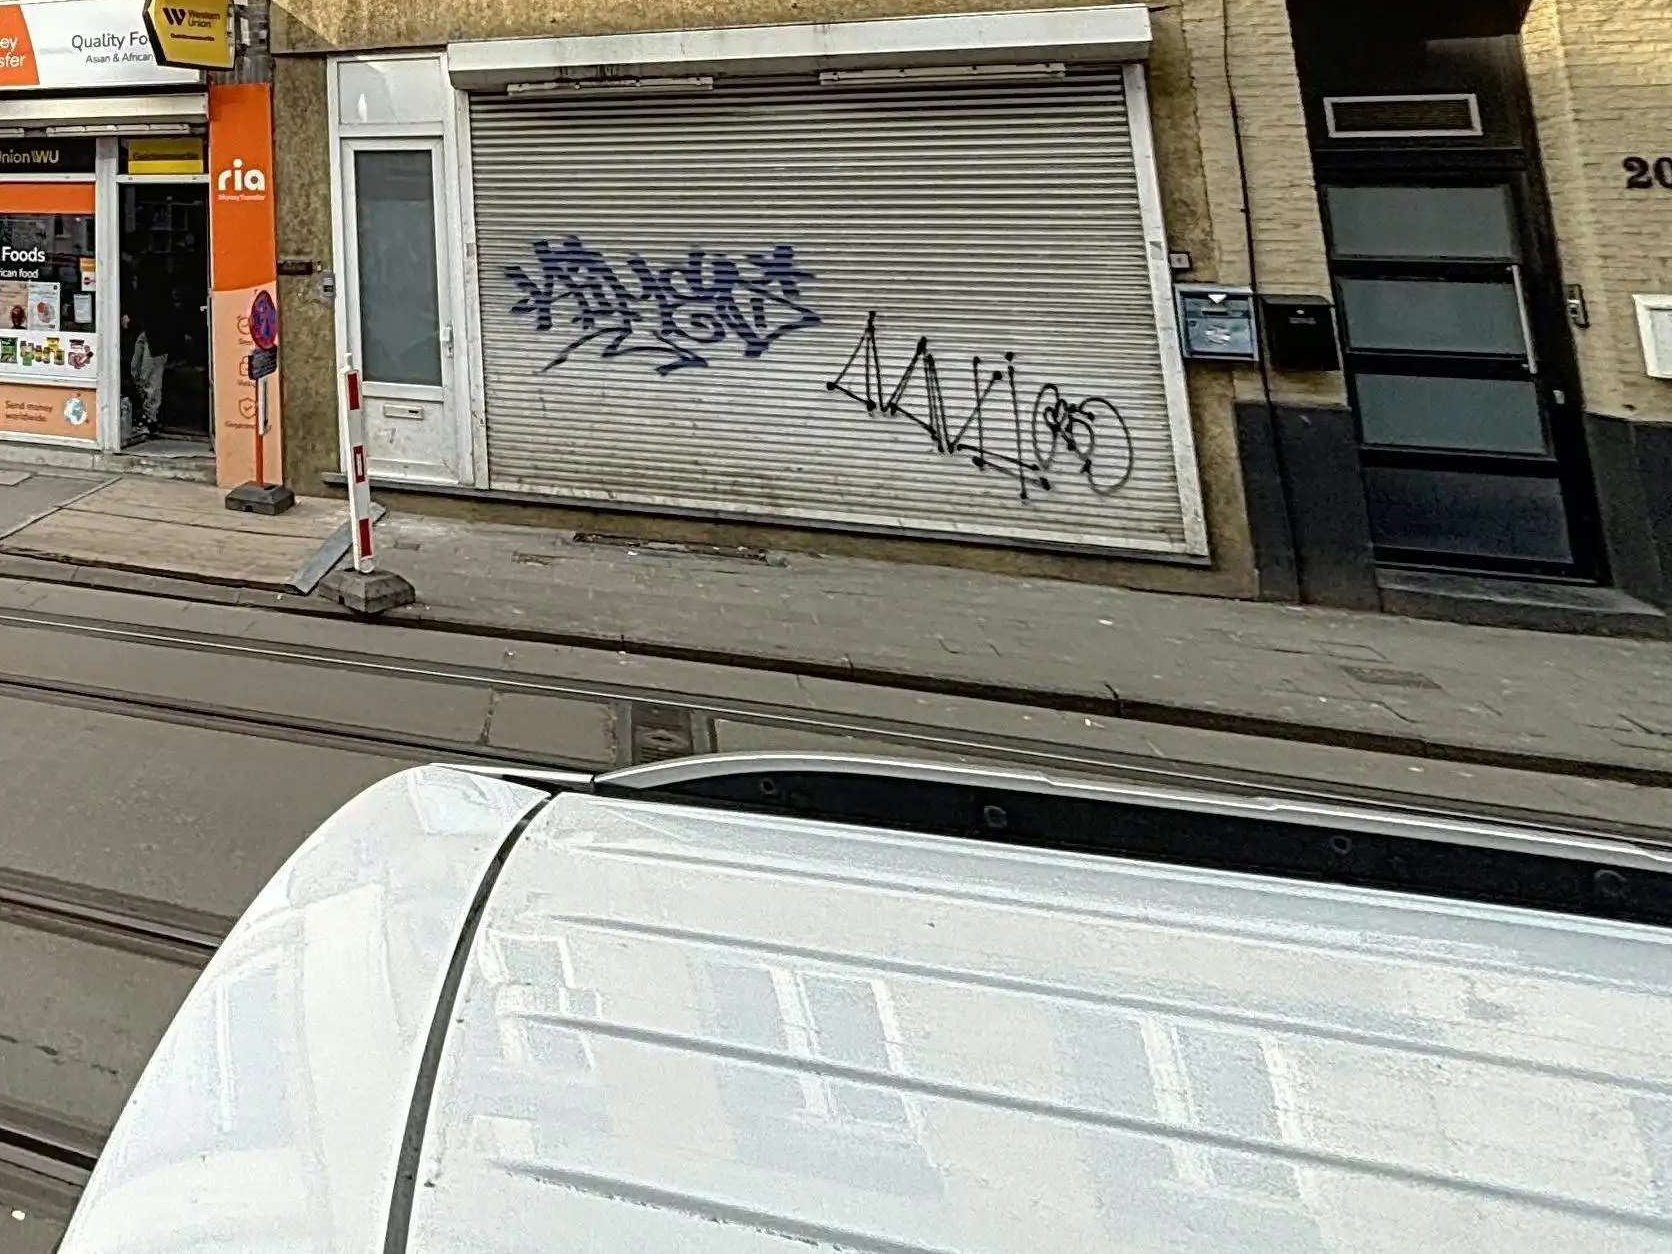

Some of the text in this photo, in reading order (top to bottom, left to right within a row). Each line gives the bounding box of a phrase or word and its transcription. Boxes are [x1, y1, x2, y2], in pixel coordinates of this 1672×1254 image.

[188, 18, 212, 29] Union
[71, 33, 126, 51] Quality
[129, 31, 150, 47] Fo
[85, 54, 111, 64] Asian
[112, 53, 120, 63] &
[218, 158, 266, 191] ria
[2, 246, 46, 262] Foods
[18, 268, 39, 279] food
